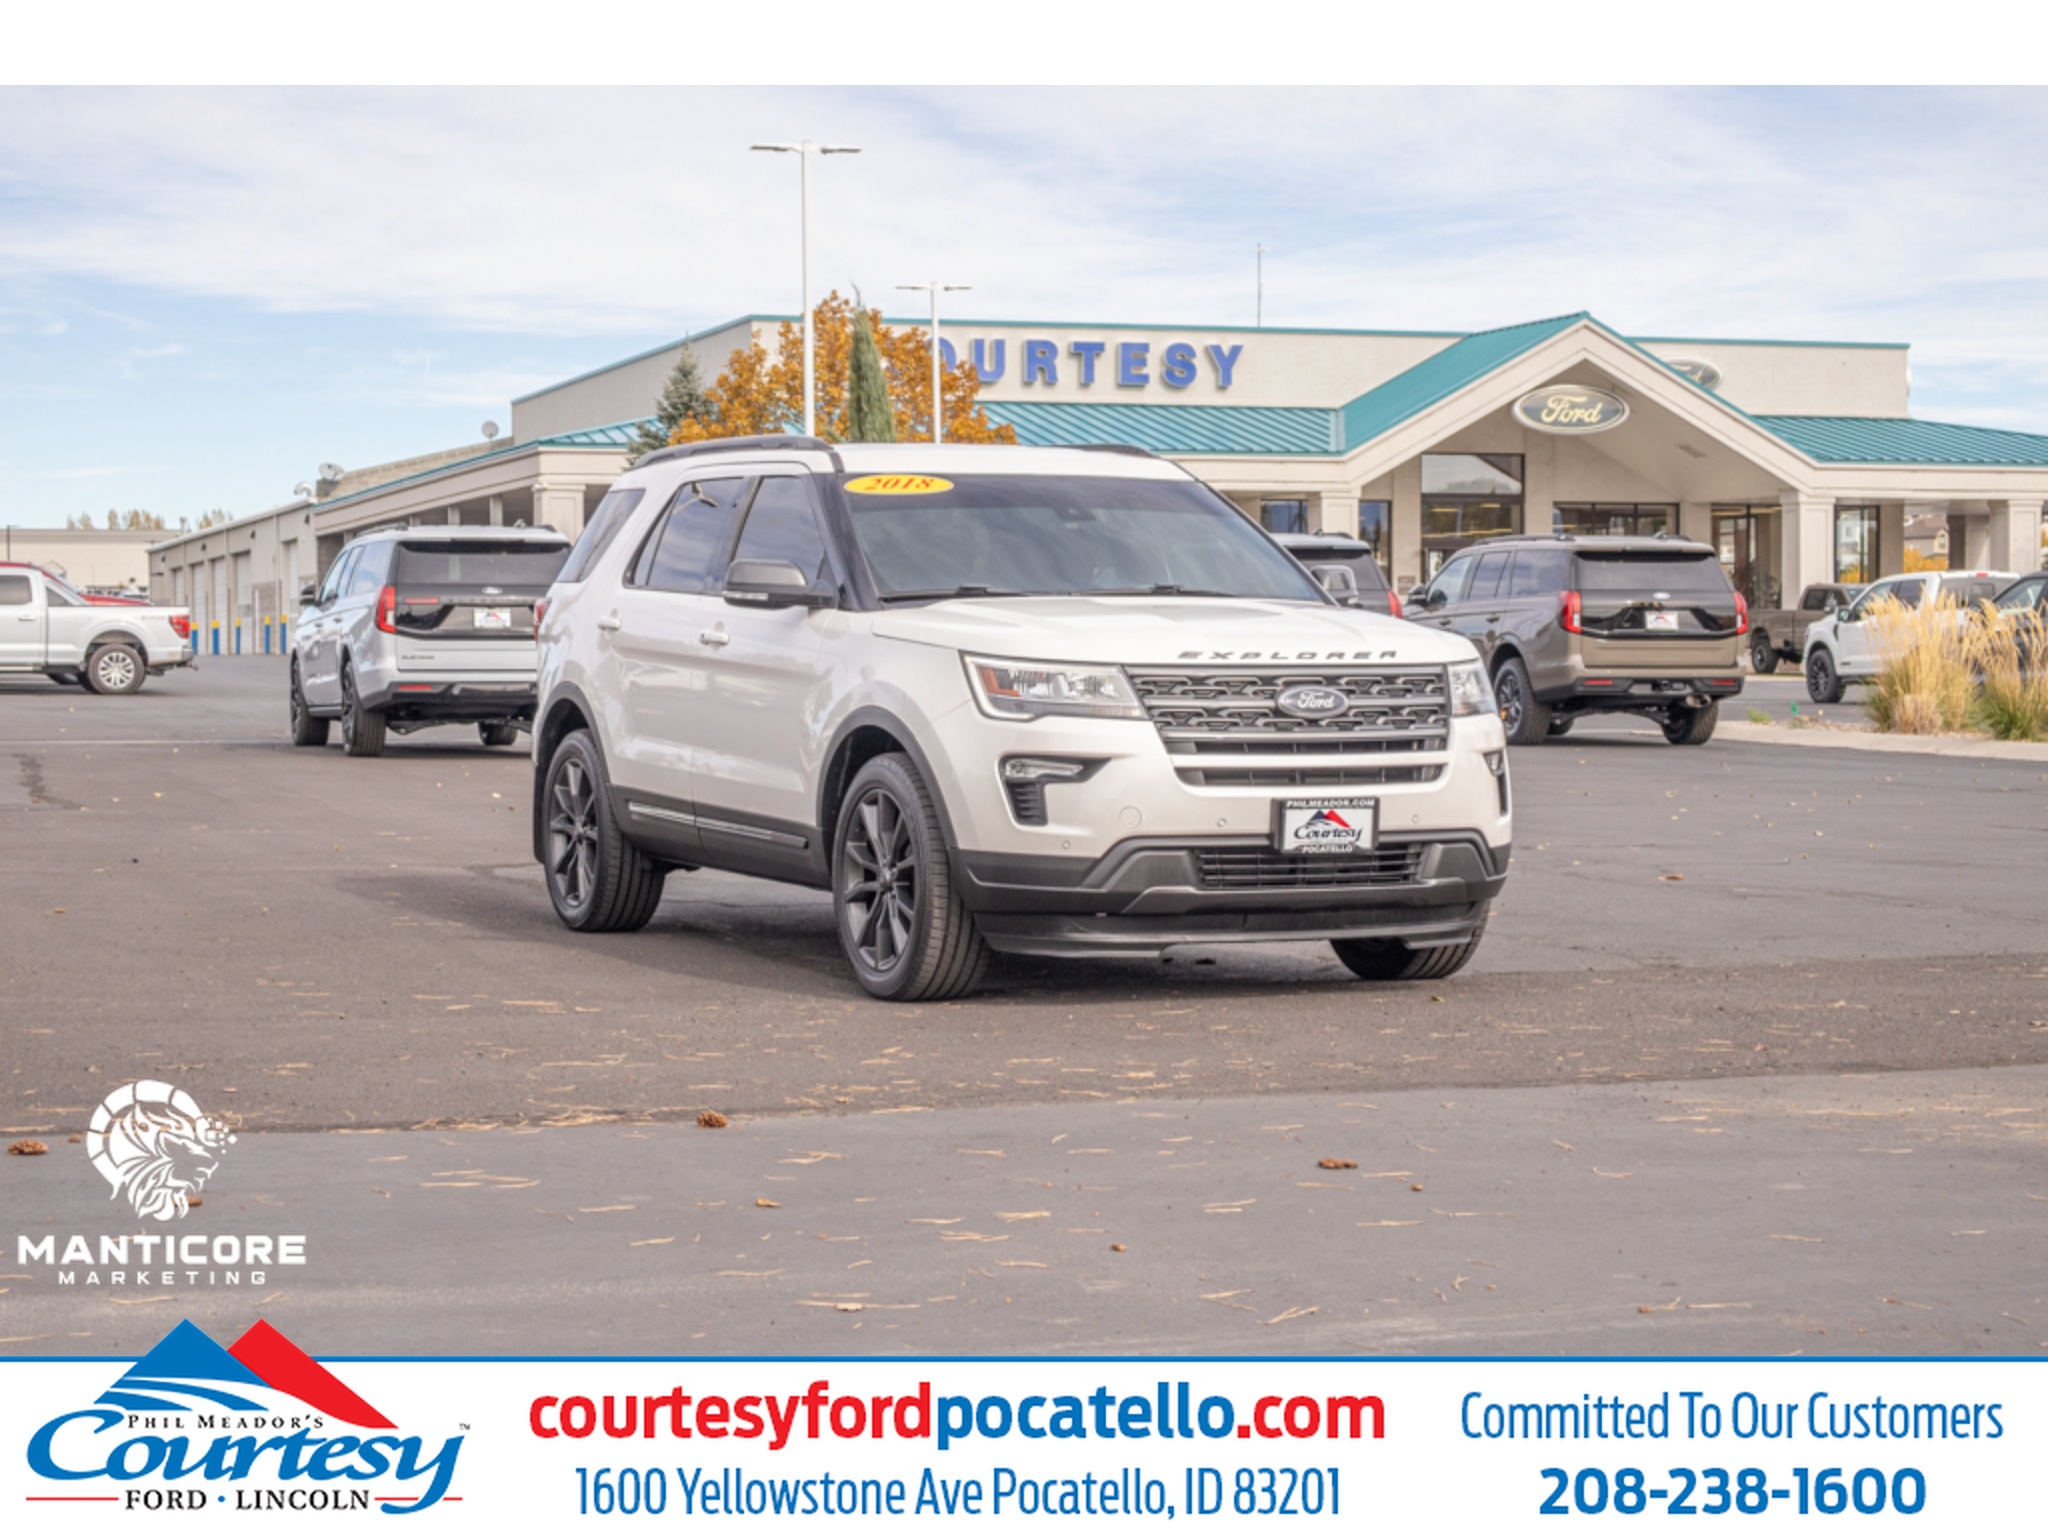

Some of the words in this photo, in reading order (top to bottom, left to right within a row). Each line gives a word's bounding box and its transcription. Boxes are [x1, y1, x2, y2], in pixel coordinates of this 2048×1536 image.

[925, 337, 1245, 388] URTESY
[1541, 394, 1603, 424] Ford
[864, 478, 935, 491] 2018
[1178, 650, 1397, 660] EXPLORER
[1297, 690, 1335, 709] Ford
[1286, 799, 1375, 808] PHILMEADOR.COM
[1294, 824, 1363, 841] Courtesy
[1302, 844, 1353, 853] POCATELLO
